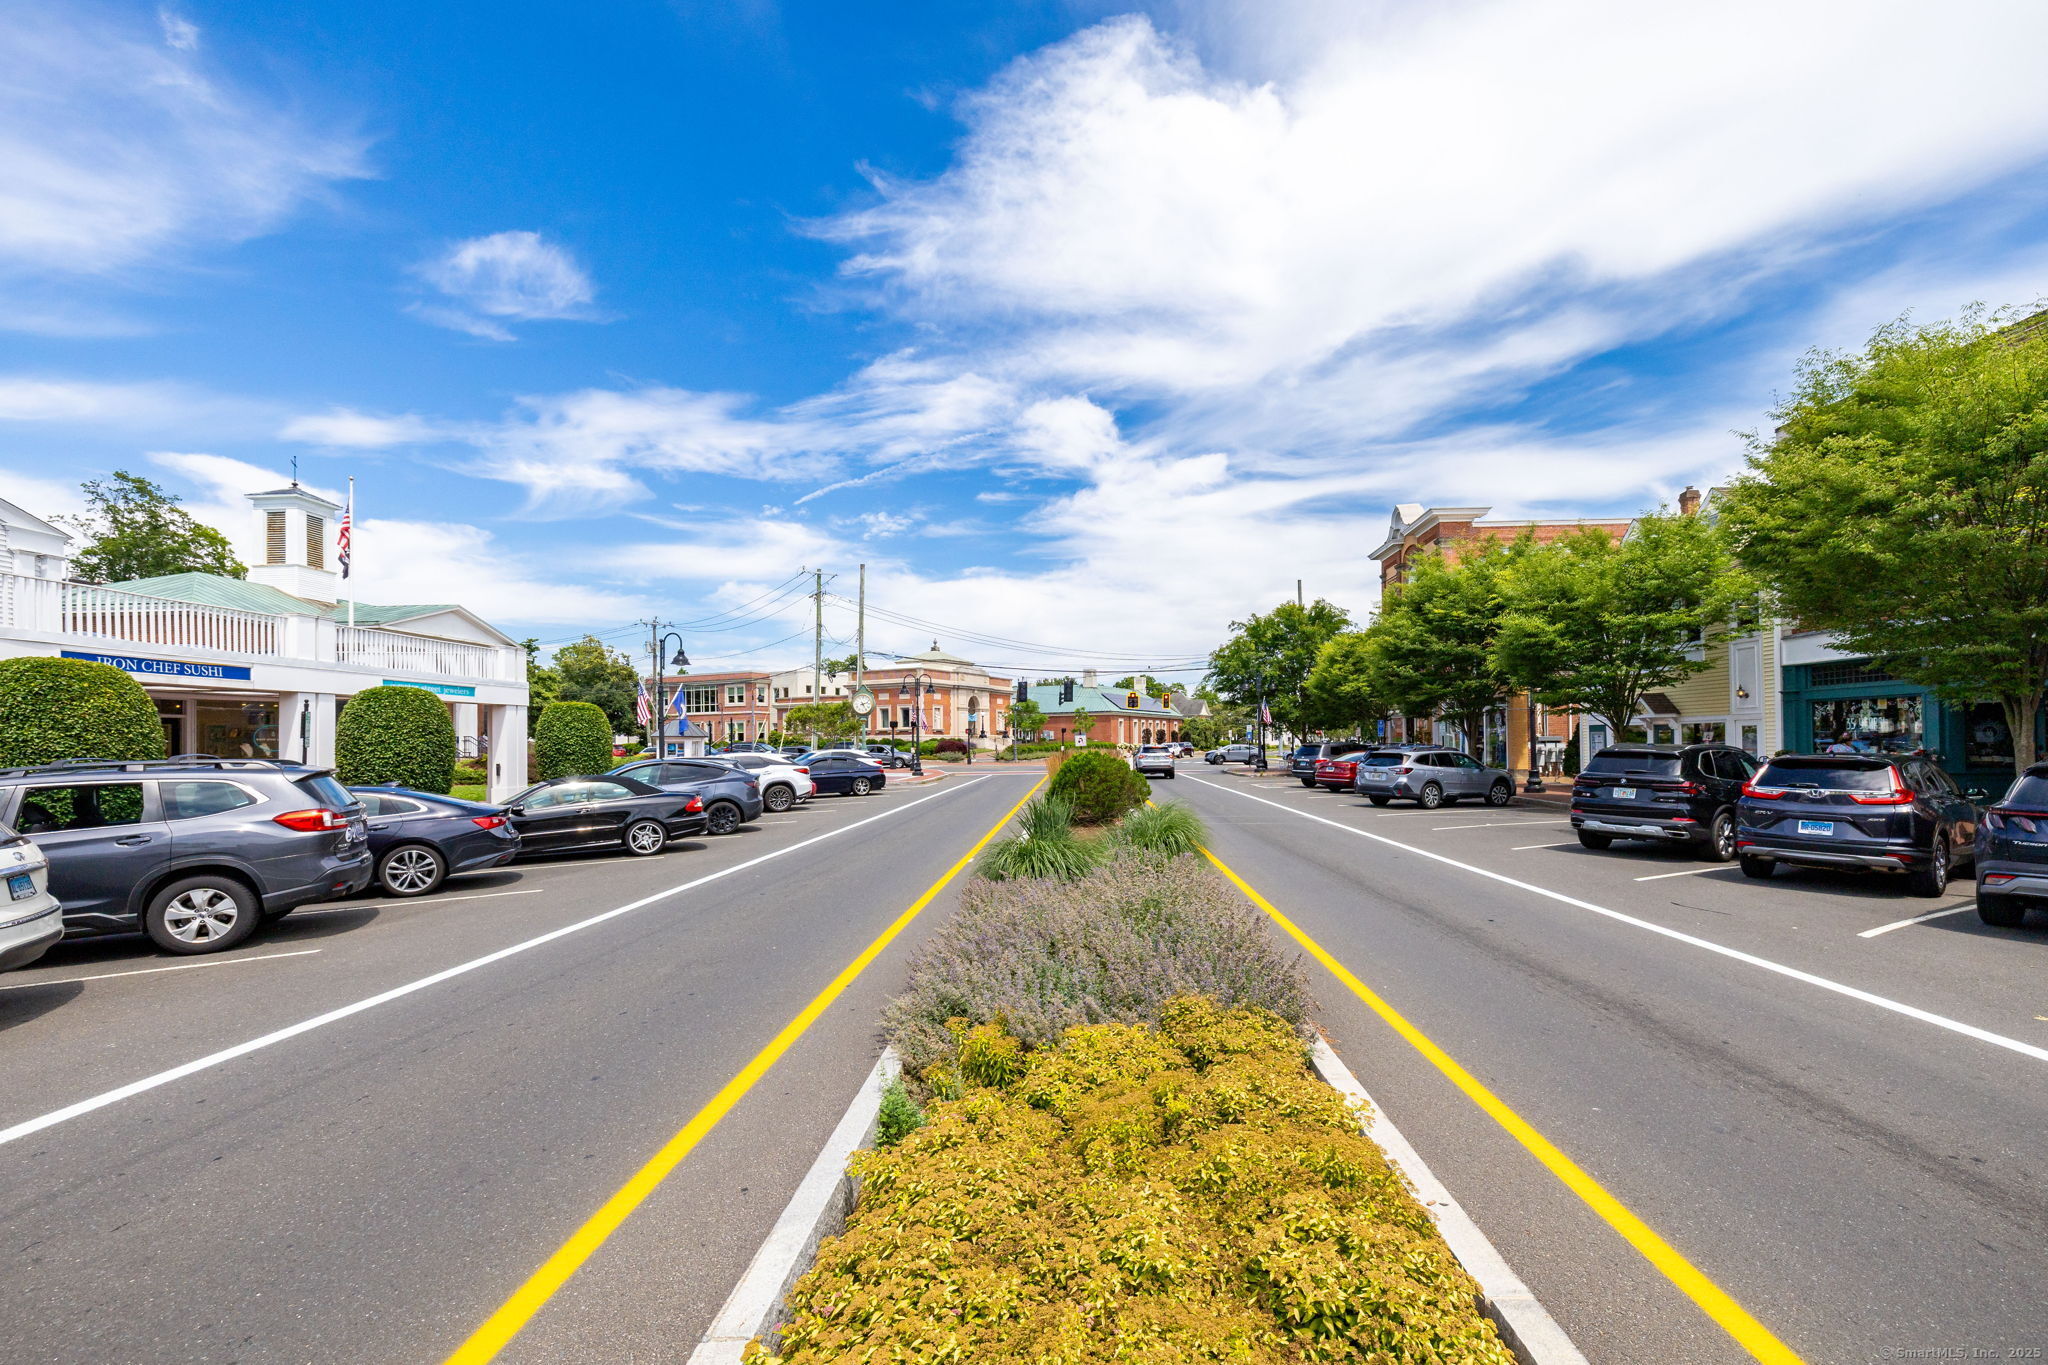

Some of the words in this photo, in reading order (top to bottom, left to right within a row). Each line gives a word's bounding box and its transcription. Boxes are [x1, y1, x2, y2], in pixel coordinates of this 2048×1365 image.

[97, 656, 138, 671] IRON
[141, 660, 181, 674] CHEF
[183, 665, 224, 677] SUSHI
[443, 686, 470, 695] jewelers
